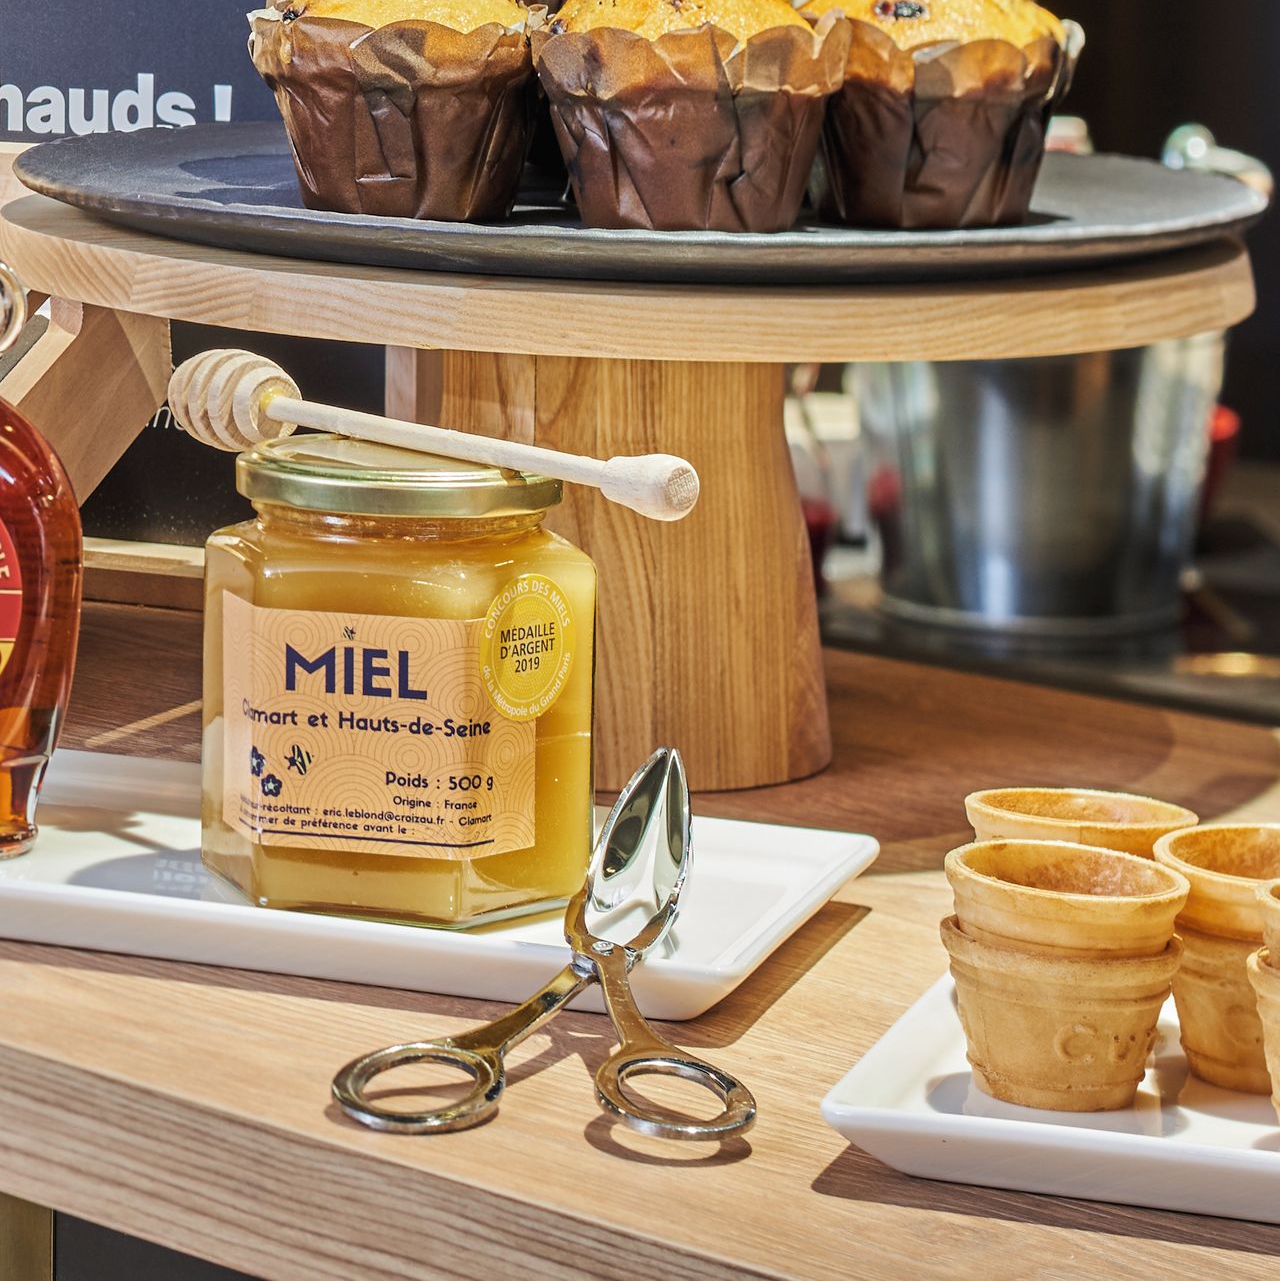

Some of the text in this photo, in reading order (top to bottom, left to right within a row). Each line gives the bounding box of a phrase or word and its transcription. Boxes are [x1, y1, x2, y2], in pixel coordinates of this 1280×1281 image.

[485, 580, 571, 639] CONCOURS DES MIELS
[500, 622, 556, 643] MÉDAILLE
[500, 638, 556, 659] D'ARGENT
[285, 640, 428, 701] MIEL
[515, 656, 540, 673] 2019
[492, 690, 528, 716] Métropole
[540, 681, 561, 708] Grand
[560, 652, 571, 680] Paris
[307, 711, 329, 728] et
[338, 711, 492, 738] Hauts-de-Seine
[385, 771, 429, 789] Poids
[448, 775, 481, 791] 500
[486, 774, 495, 791] g
[393, 796, 432, 811] Origine
[444, 799, 478, 811] France
[283, 815, 296, 826] de
[300, 817, 359, 831] préférence
[363, 822, 394, 833] avant
[397, 824, 408, 834] le
[322, 807, 445, 826] eric.leblond@croizau.fr
[458, 813, 493, 827] Clamart
